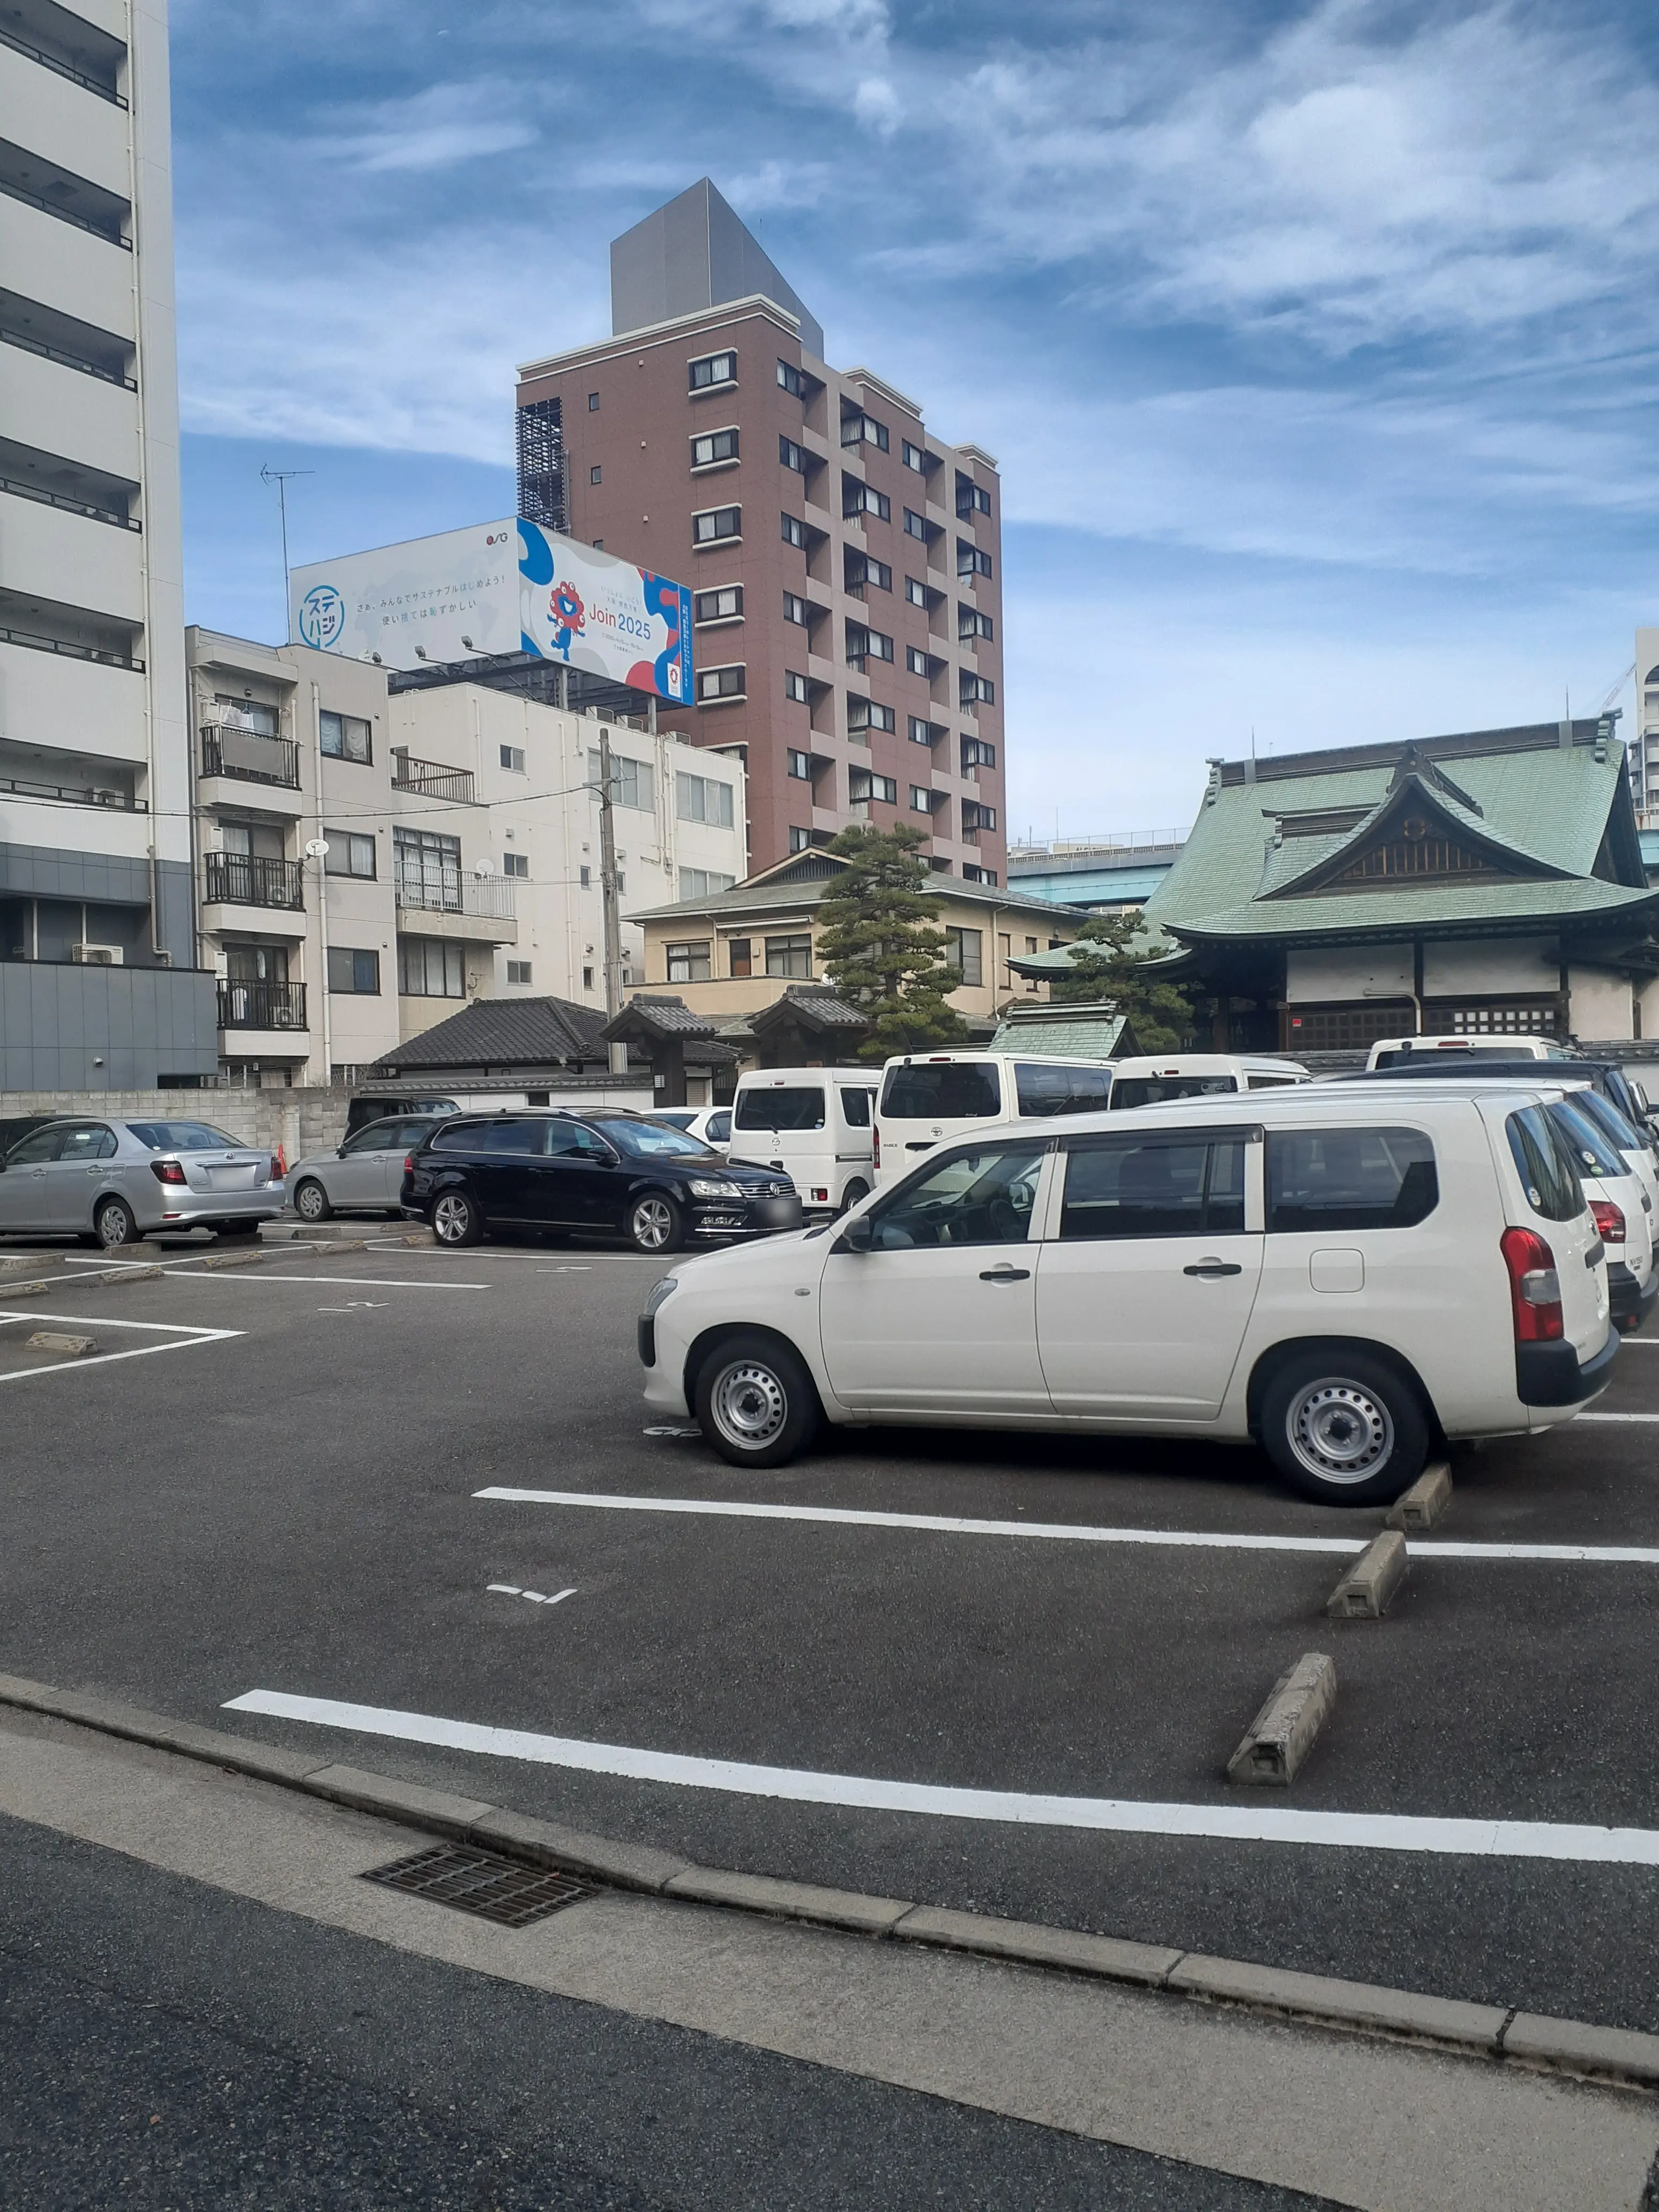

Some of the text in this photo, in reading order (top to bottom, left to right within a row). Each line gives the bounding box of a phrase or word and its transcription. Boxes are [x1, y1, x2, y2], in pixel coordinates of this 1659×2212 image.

[382, 600, 476, 626] 使い捨ては恥ずかしい
[589, 603, 651, 640] Join 2025
